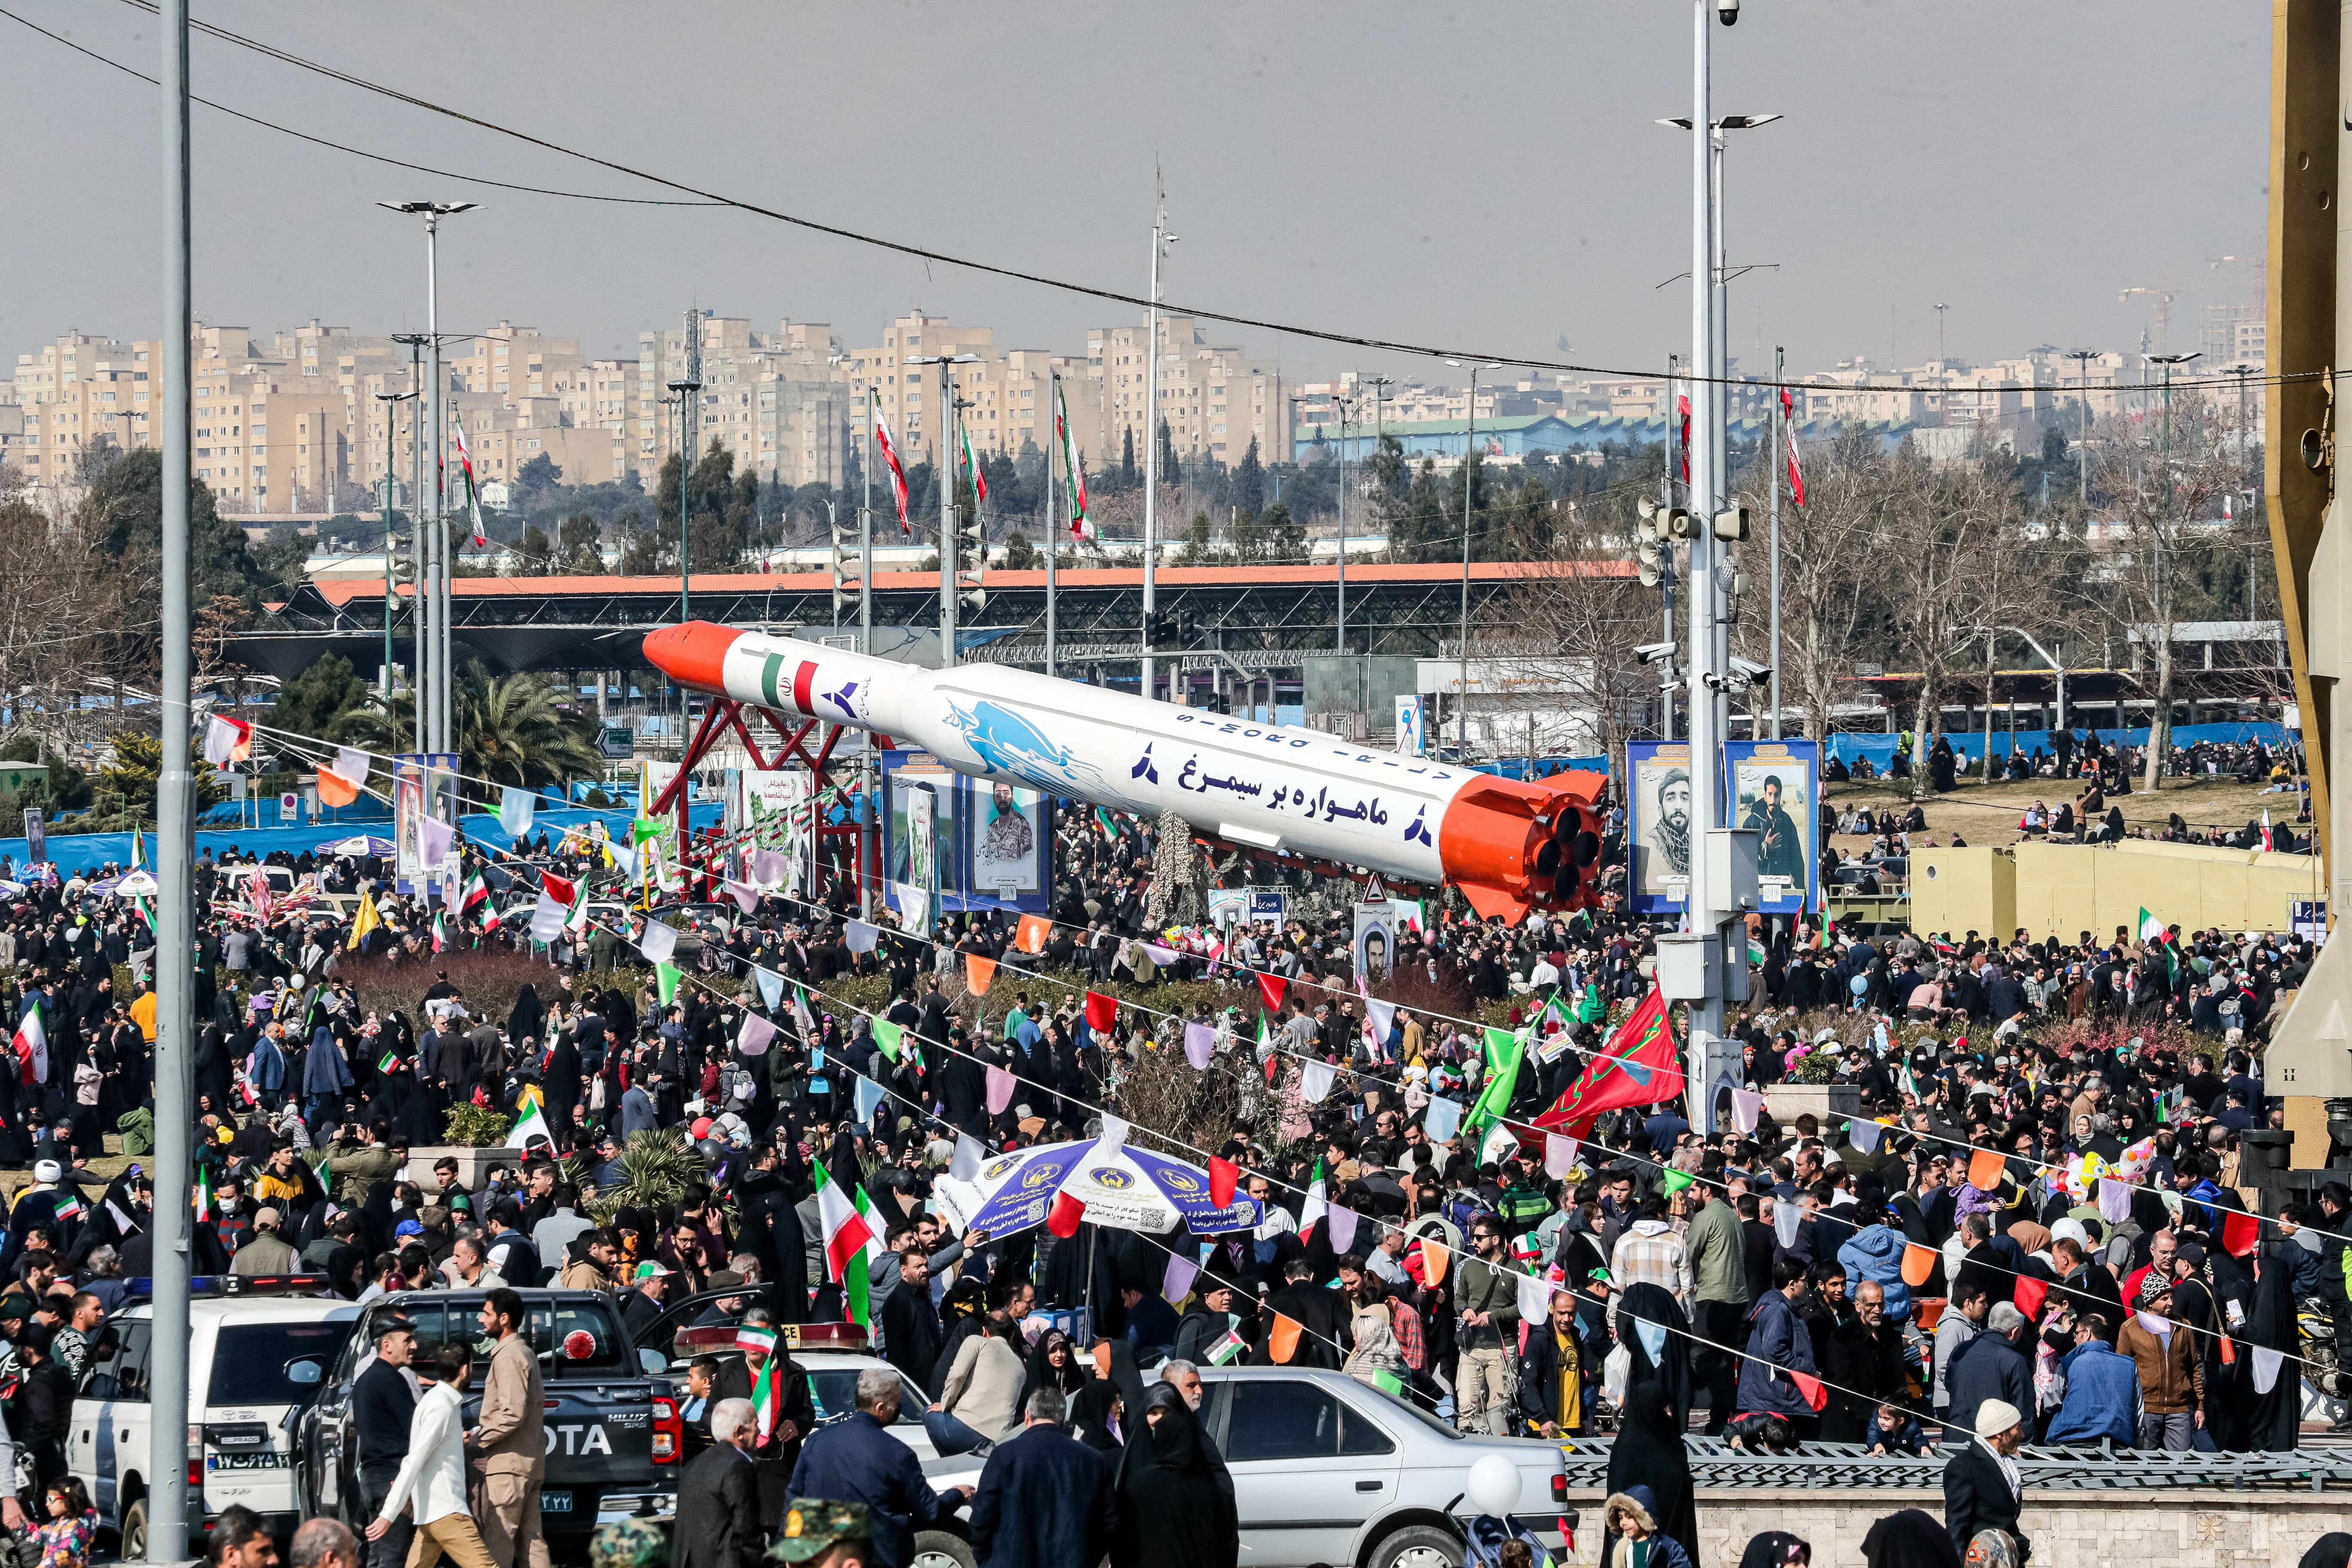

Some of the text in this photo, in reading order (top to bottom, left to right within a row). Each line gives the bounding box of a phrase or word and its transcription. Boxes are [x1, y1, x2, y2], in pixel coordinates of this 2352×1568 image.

[1177, 714, 1312, 748] SIMORQ
[1178, 753, 1388, 826] ماهواره بر سیمرغ
[608, 1413, 648, 1422] HILUX
